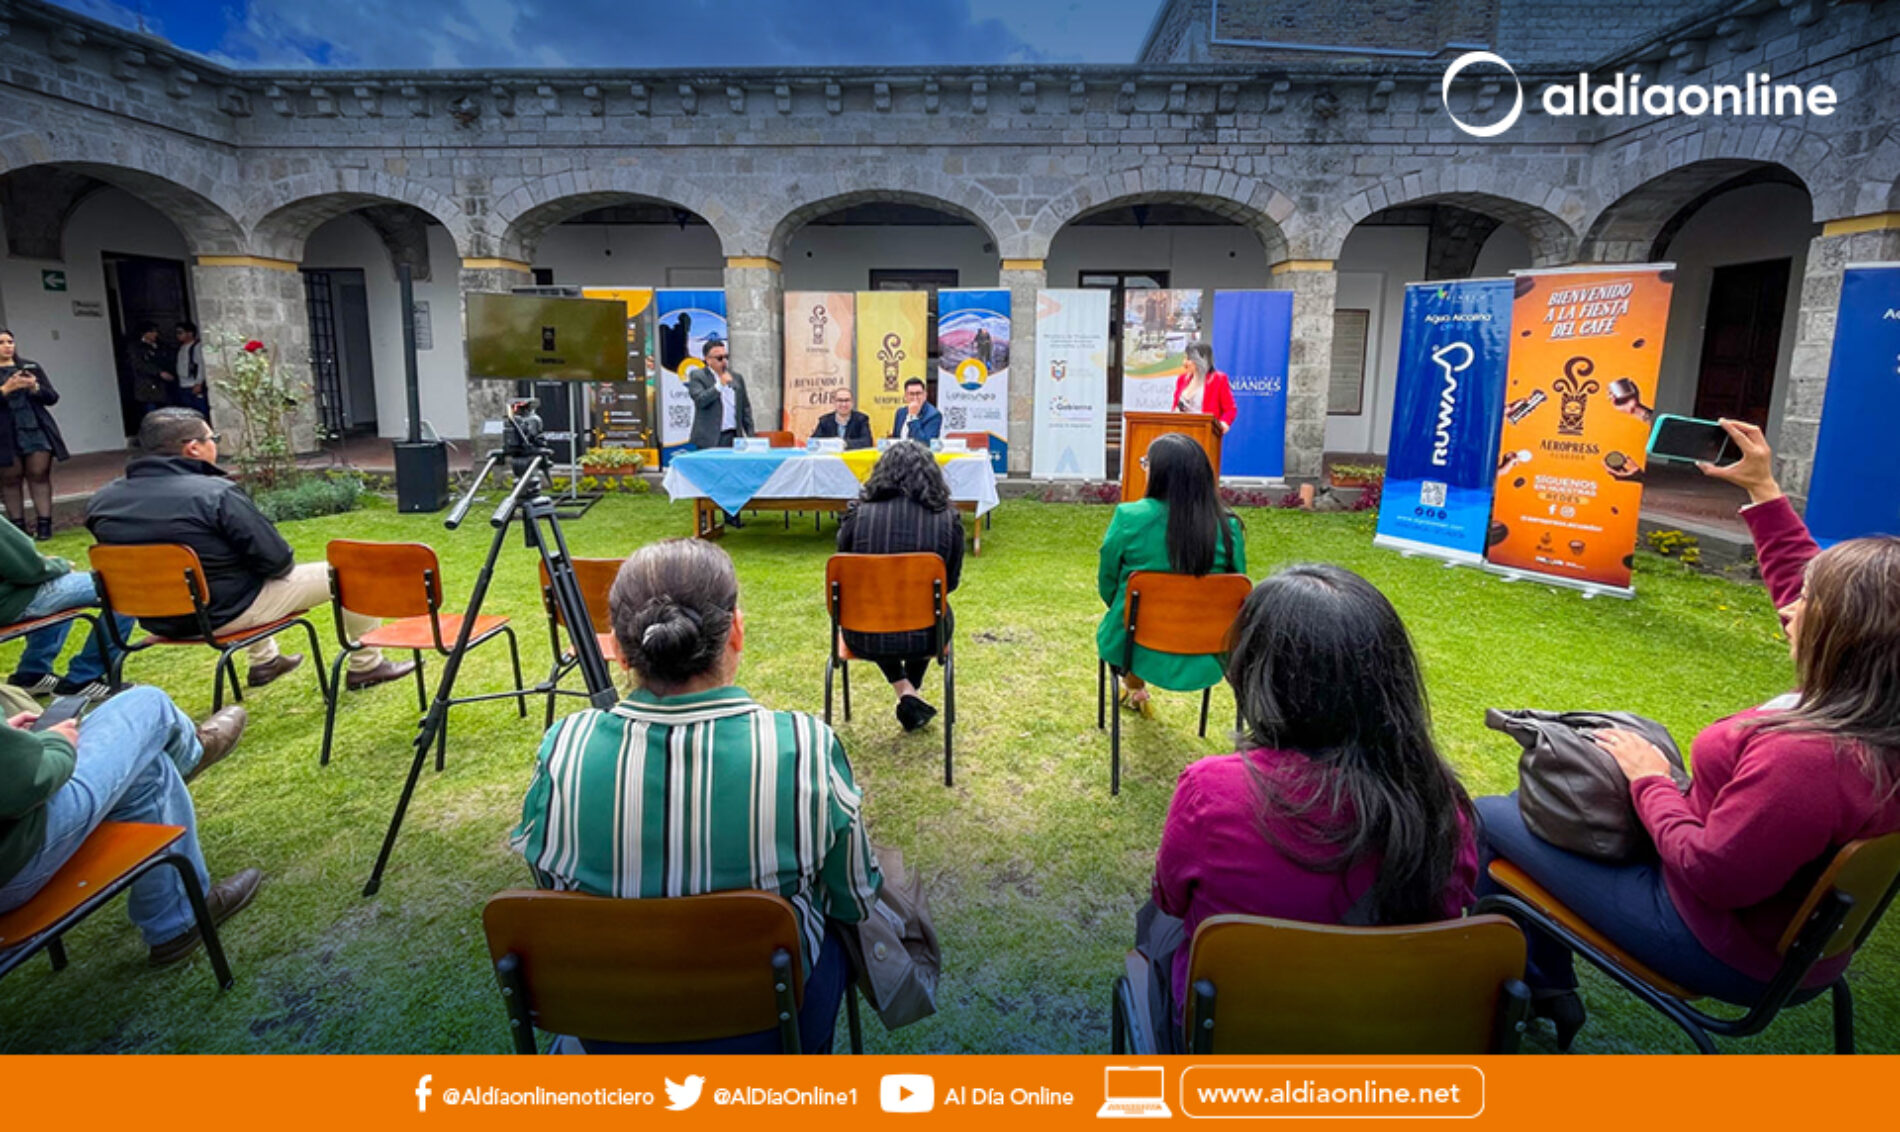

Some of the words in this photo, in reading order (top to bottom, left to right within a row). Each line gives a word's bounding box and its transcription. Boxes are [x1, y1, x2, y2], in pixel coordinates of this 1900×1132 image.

[1548, 283, 1633, 306] BIENVENIDO
[1544, 307, 1555, 323] A
[1557, 306, 1577, 321] LA
[1578, 300, 1630, 319] FIESTA
[1550, 322, 1575, 337] DEL
[1229, 380, 1282, 391] NIANDES
[1540, 439, 1600, 454] AEROPRESS
